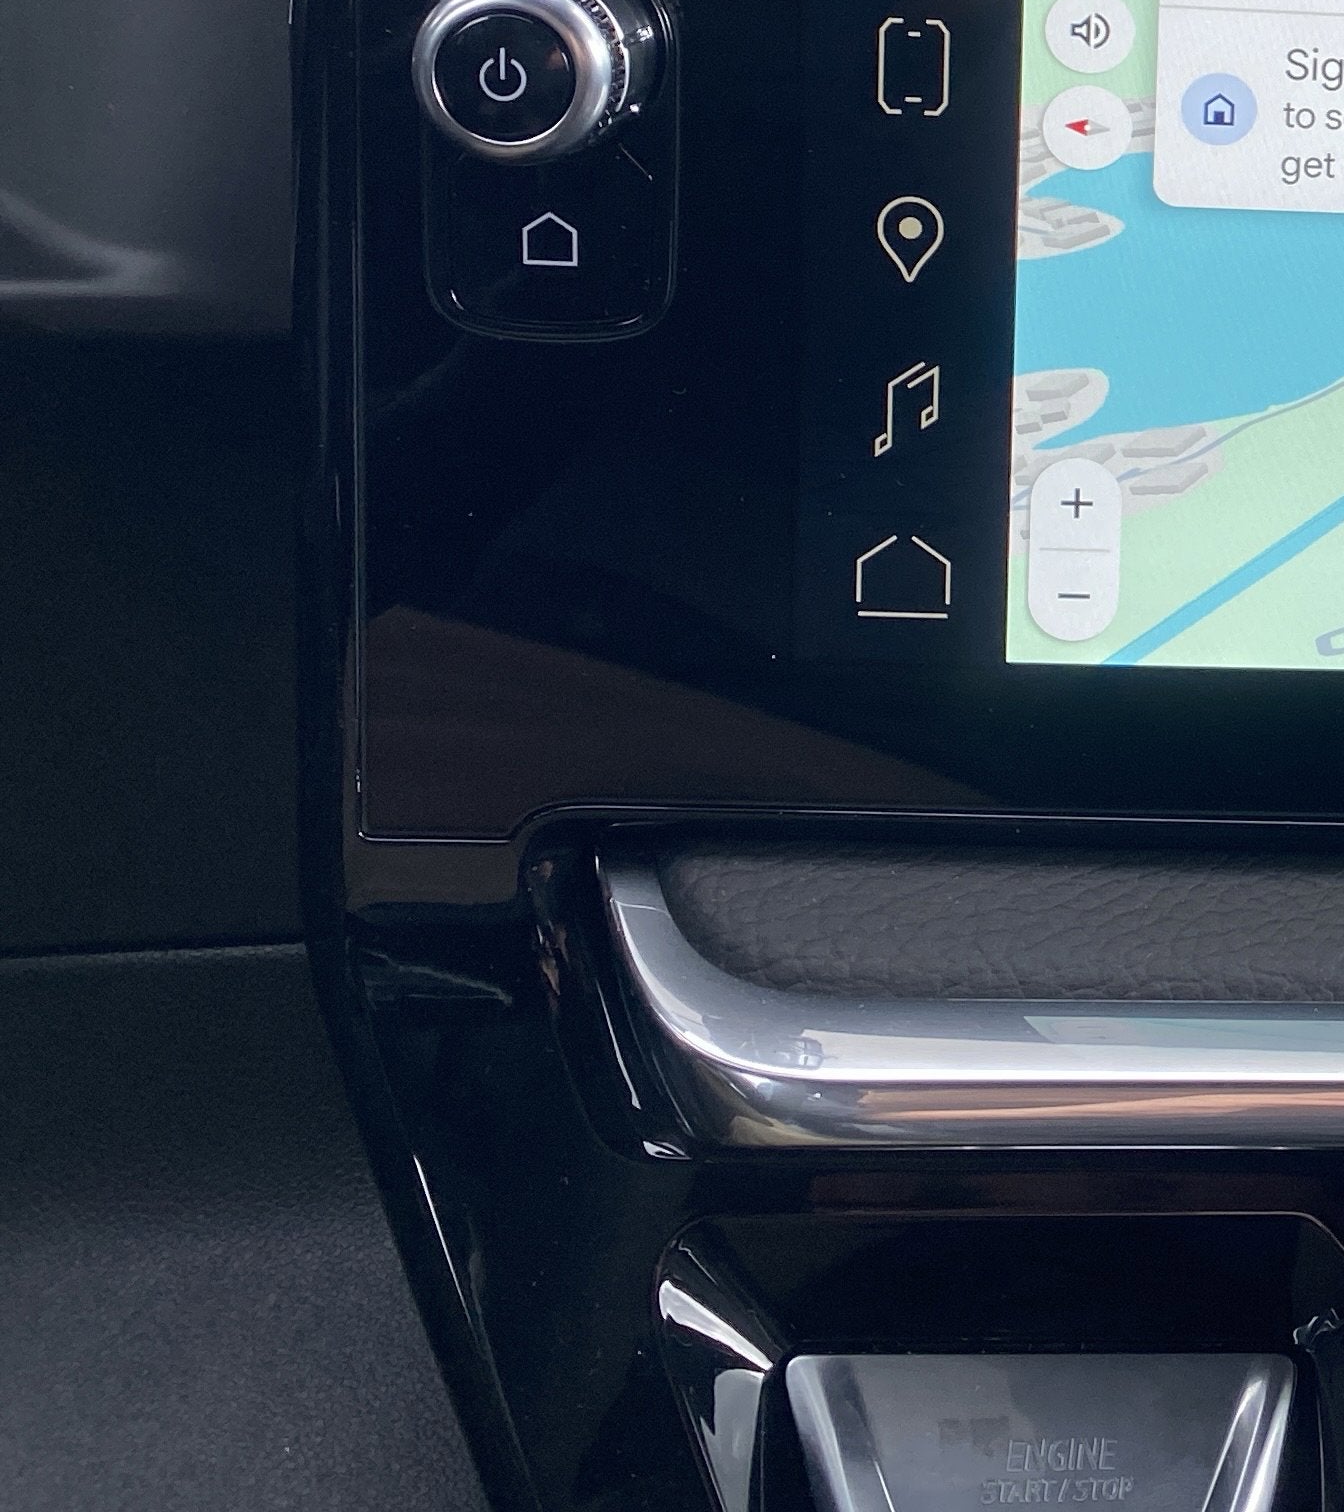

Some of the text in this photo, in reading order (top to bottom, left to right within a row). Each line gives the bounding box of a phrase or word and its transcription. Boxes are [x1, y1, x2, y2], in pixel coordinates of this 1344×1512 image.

[1283, 102, 1316, 129] to
[1281, 153, 1336, 185] get
[1006, 1437, 1119, 1473] ENGINE
